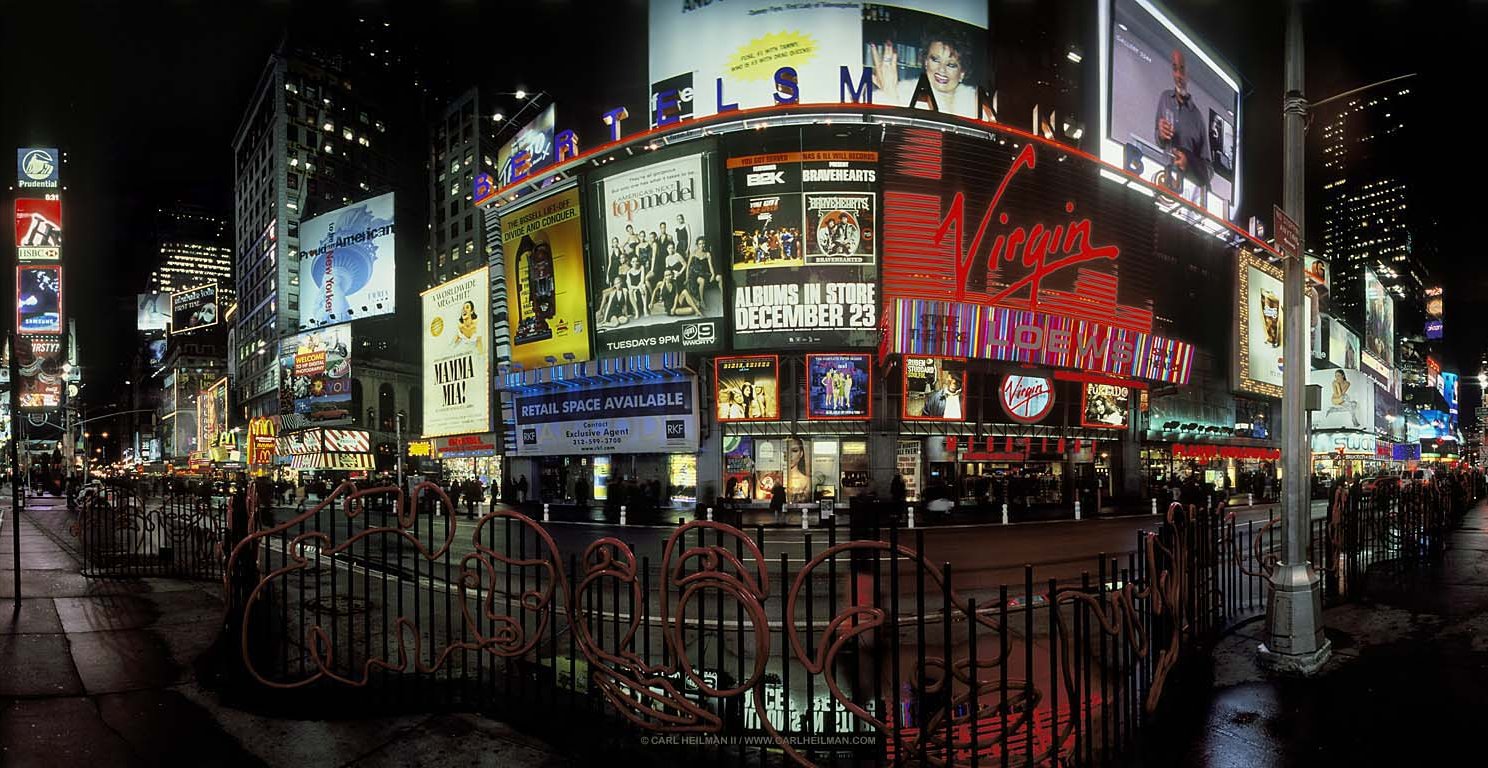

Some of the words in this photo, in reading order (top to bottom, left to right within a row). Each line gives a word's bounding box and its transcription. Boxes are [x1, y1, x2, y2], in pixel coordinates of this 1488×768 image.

[18, 180, 58, 188] Prudential
[802, 169, 876, 182] BRAVEHEARTS
[612, 199, 639, 222] top
[640, 177, 696, 210] model
[808, 196, 870, 211] BRAVEHEARTS
[336, 222, 395, 249] American
[504, 227, 526, 242] DIVIDE
[526, 221, 542, 234] AND
[507, 220, 519, 229] THE
[932, 142, 1119, 314] Virgin
[325, 250, 334, 275] New
[325, 277, 334, 313] Yorker
[735, 283, 799, 308] ALBUMS
[803, 283, 821, 305] IN
[826, 282, 876, 304] STORE
[735, 304, 844, 331] DECEMBER
[849, 303, 876, 327] 23
[606, 337, 657, 351] TUESDAYS
[658, 334, 680, 344] 9PM
[988, 320, 1133, 364] LOEWS
[295, 352, 325, 364] WELCOME
[433, 355, 475, 386] MAMMA
[328, 382, 350, 393] YOU
[442, 381, 467, 407] MIA!
[1003, 373, 1052, 418] Virgin
[521, 402, 559, 417] RETAIL
[562, 398, 601, 414] SPACE
[604, 391, 684, 410] AVAILABLE
[523, 432, 537, 441] RKF
[566, 429, 600, 438] Exclusive
[603, 428, 629, 438] Agent
[583, 421, 608, 429] Contact
[667, 423, 685, 435] RKF
